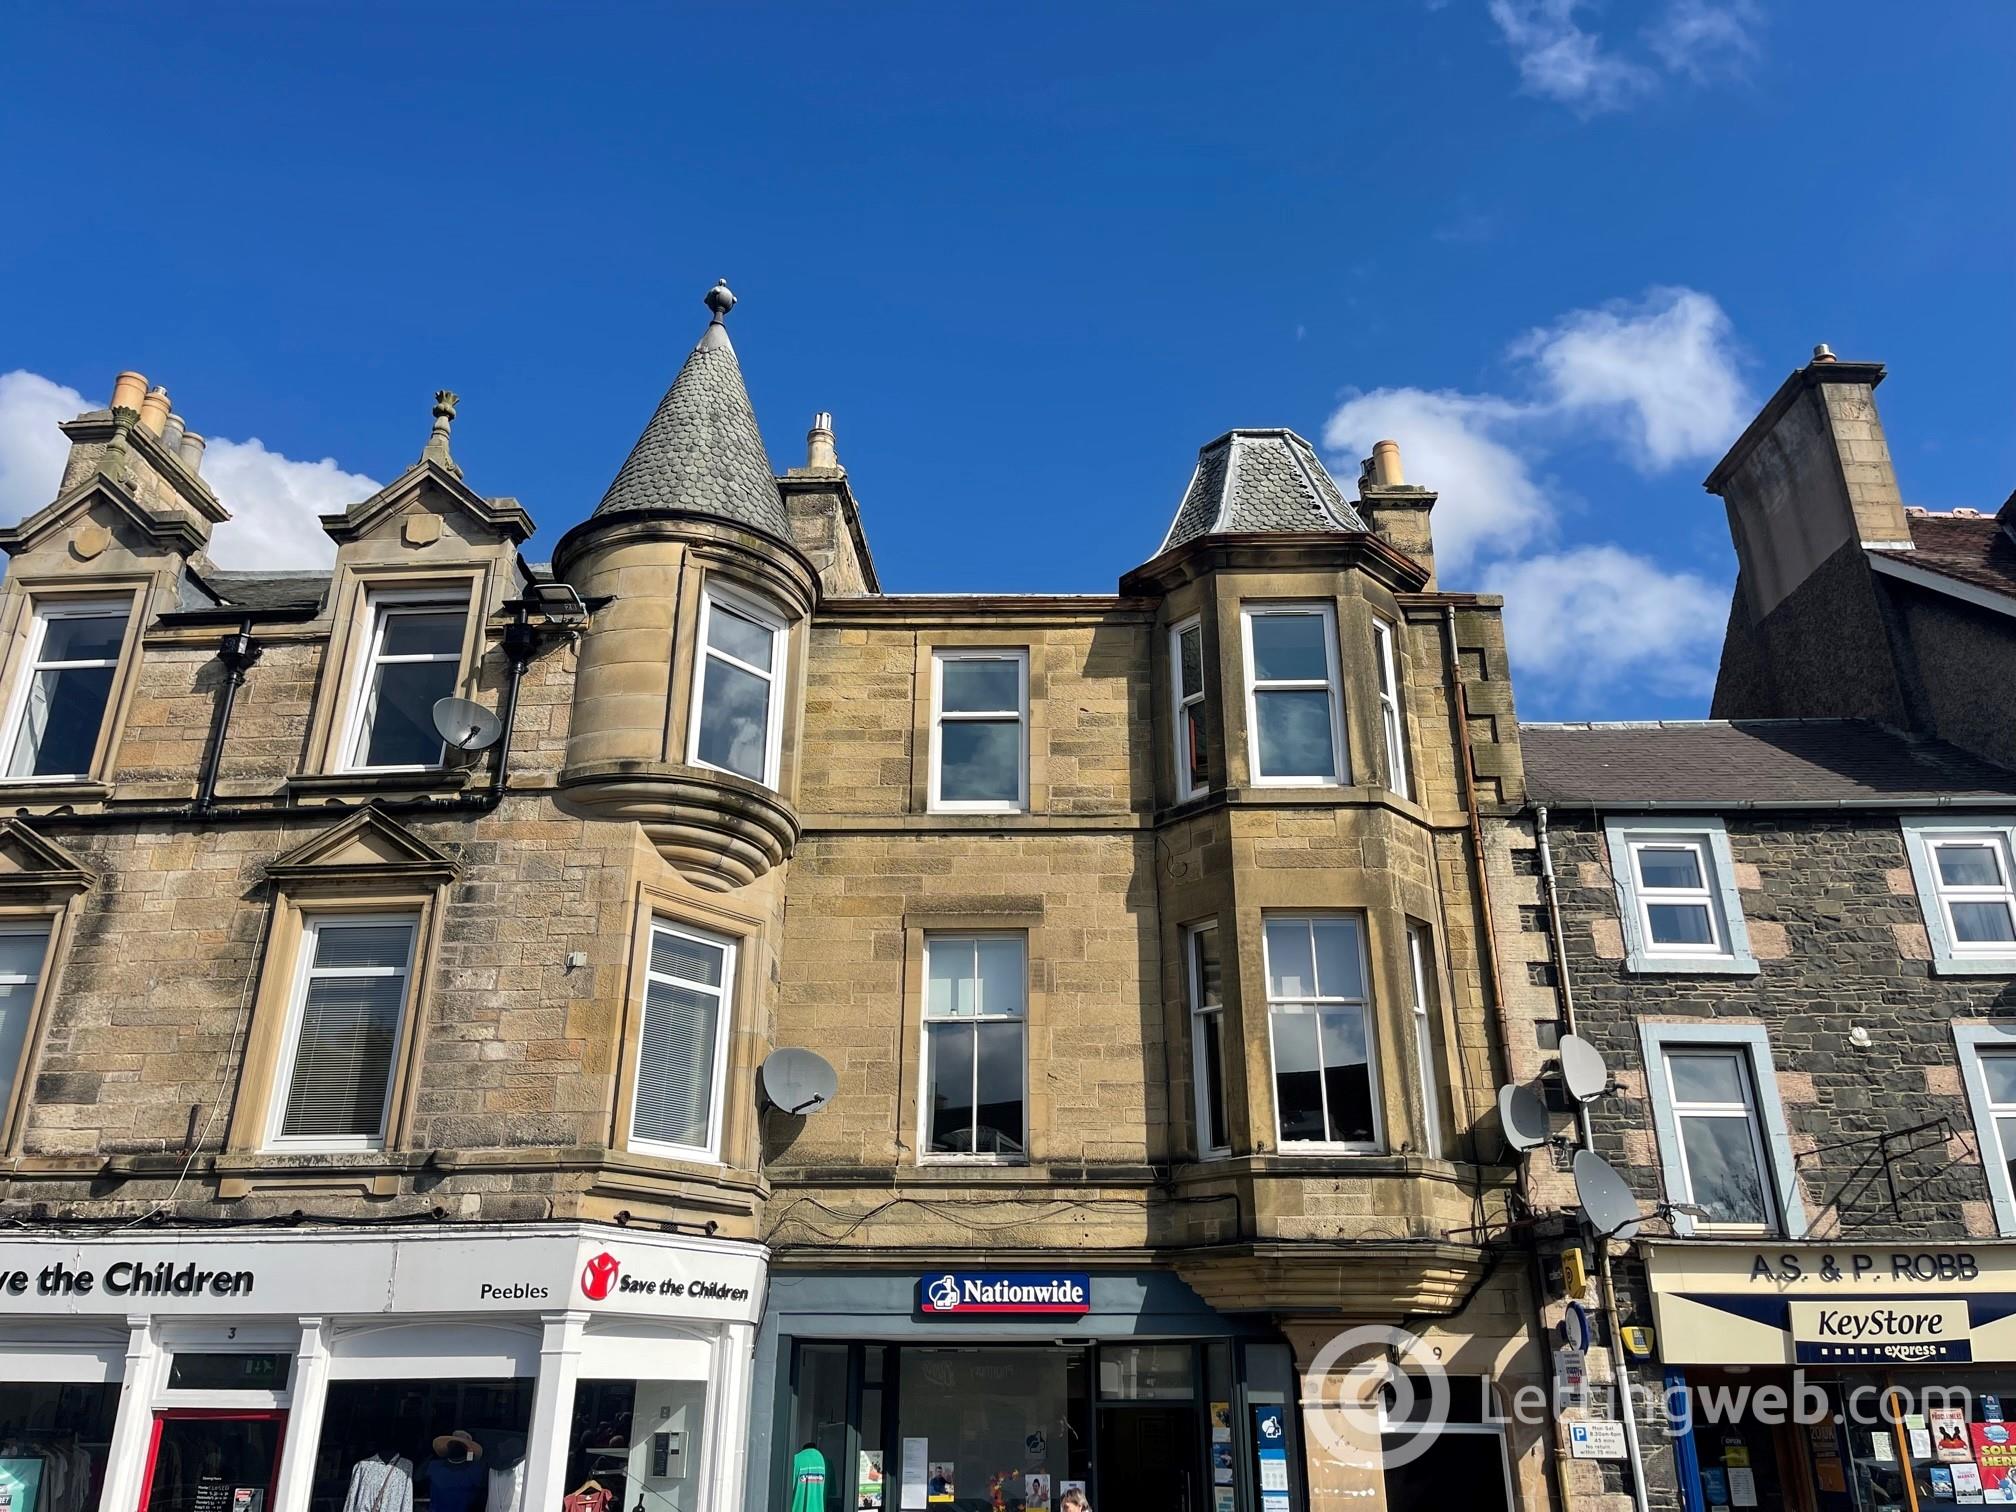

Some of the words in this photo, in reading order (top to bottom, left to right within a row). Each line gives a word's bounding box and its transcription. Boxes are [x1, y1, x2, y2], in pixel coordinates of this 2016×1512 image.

[38, 1262, 94, 1294] the
[103, 1261, 254, 1294] Children
[1820, 1254, 1842, 1281] &
[1892, 1254, 1978, 1281] ROBB
[480, 1282, 549, 1300] Peebles
[619, 1274, 656, 1294] Save
[659, 1278, 684, 1296] the
[688, 1280, 748, 1301] Children
[963, 1279, 1083, 1303] Nationwide
[228, 1327, 236, 1339] 3
[1818, 1310, 1943, 1340] KeyStore
[1432, 1346, 1442, 1360] 9
[1884, 1344, 1937, 1360] express
[1575, 1428, 1584, 1441] P
